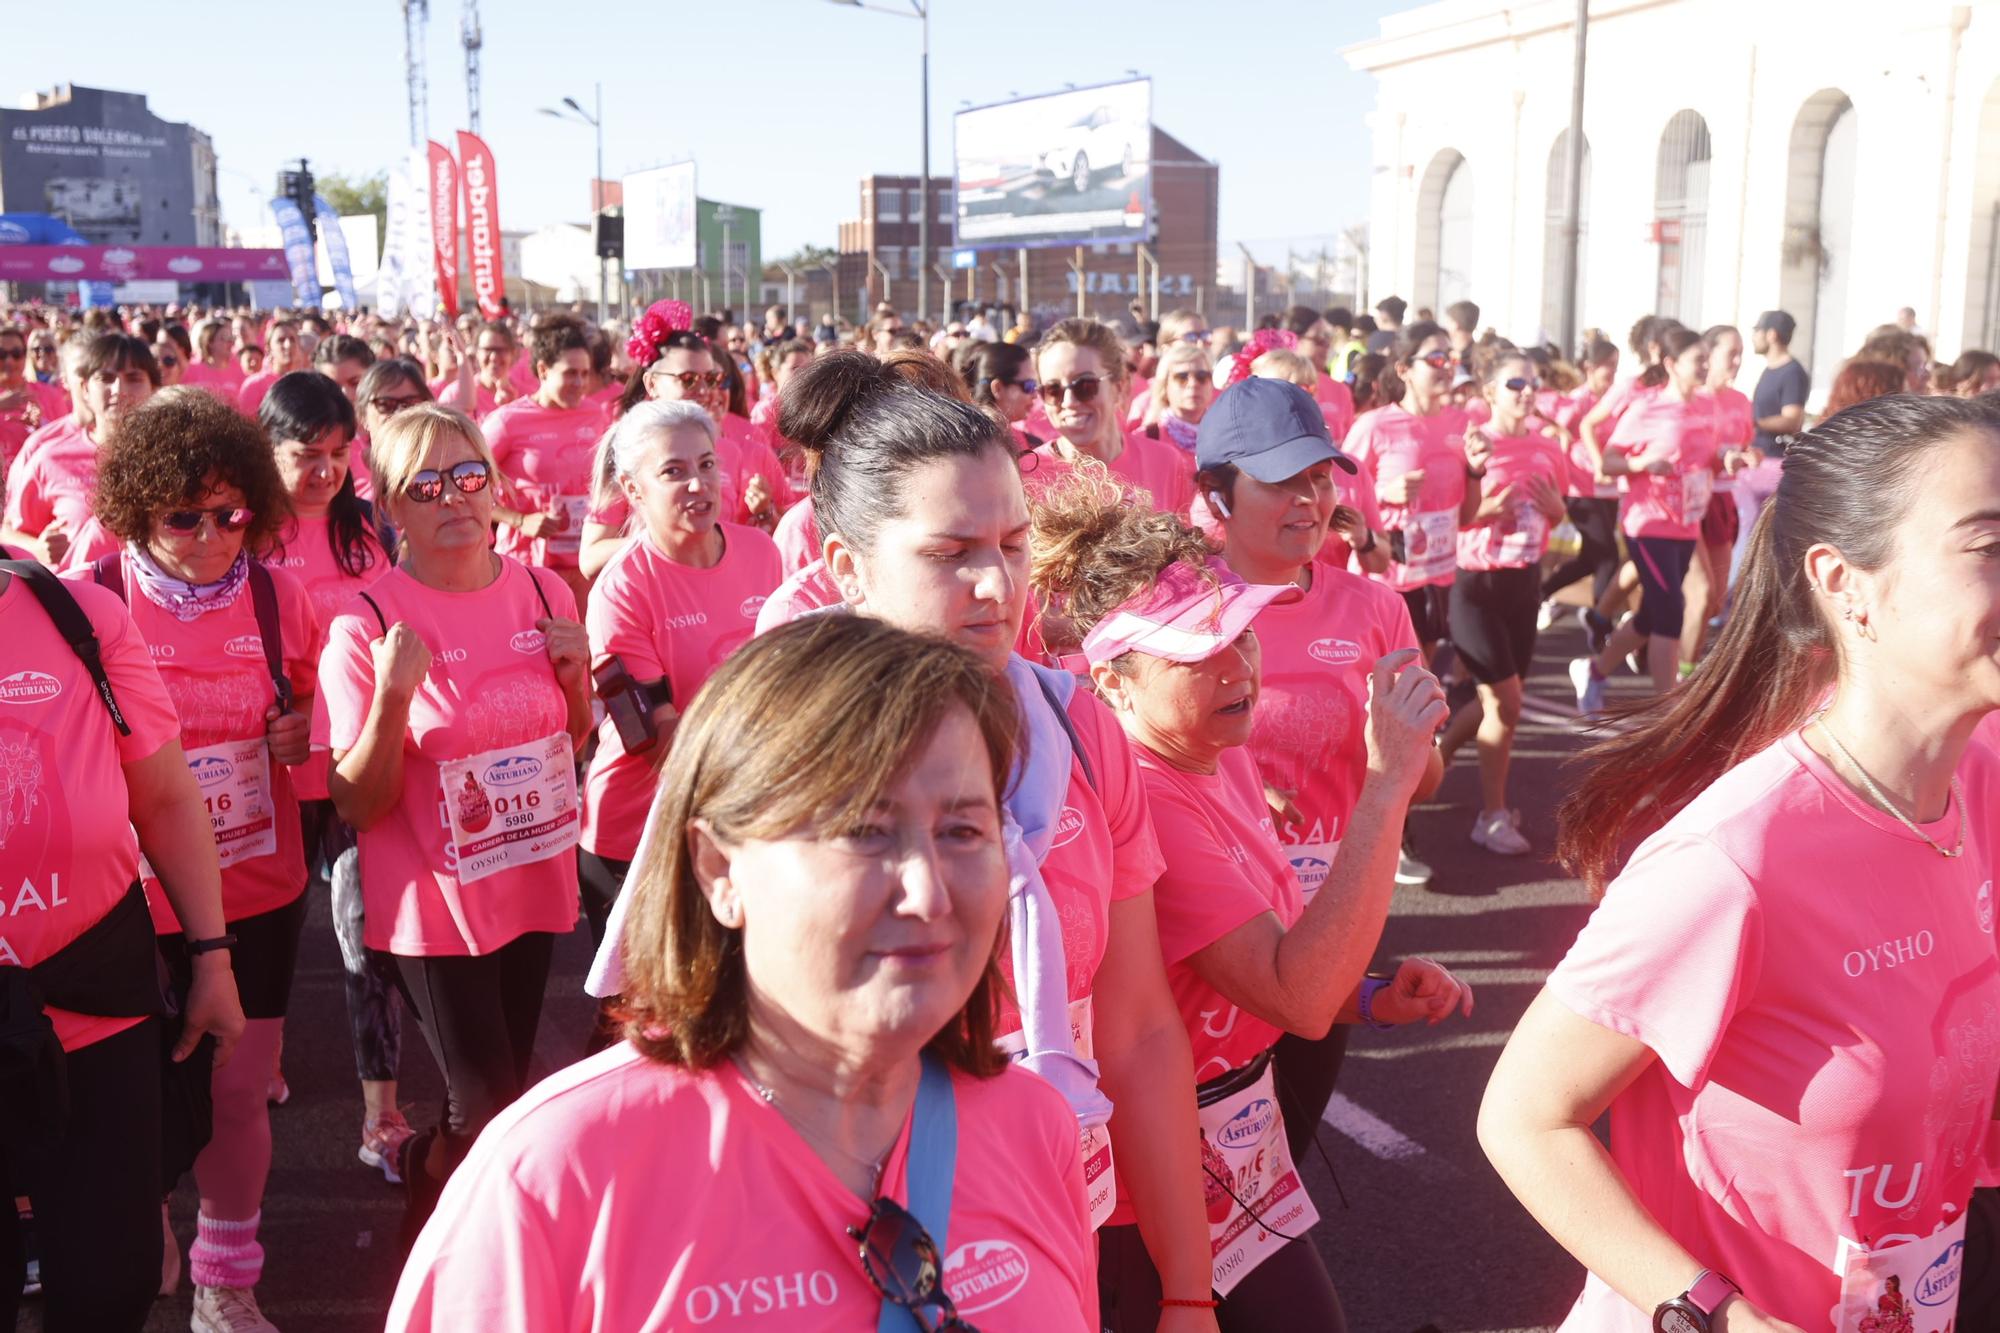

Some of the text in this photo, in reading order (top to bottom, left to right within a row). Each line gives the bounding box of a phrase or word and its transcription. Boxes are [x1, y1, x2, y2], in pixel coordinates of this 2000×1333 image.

[488, 765, 538, 783] ASTURIANA
[494, 790, 541, 814] 016
[505, 812, 535, 828] 5980
[472, 836, 505, 853] CARRERA
[506, 832, 519, 842] DE
[519, 829, 530, 839] LA
[531, 821, 556, 836] MUJER
[471, 850, 508, 872] OYSHO
[1843, 929, 1934, 978] OYSHO
[1086, 1161, 1102, 1180] 2023
[1843, 1161, 1923, 1218] TU
[949, 1257, 1025, 1303] STURIANA
[1213, 1248, 1245, 1283] OYSHO
[685, 1269, 838, 1324] OYSHO
